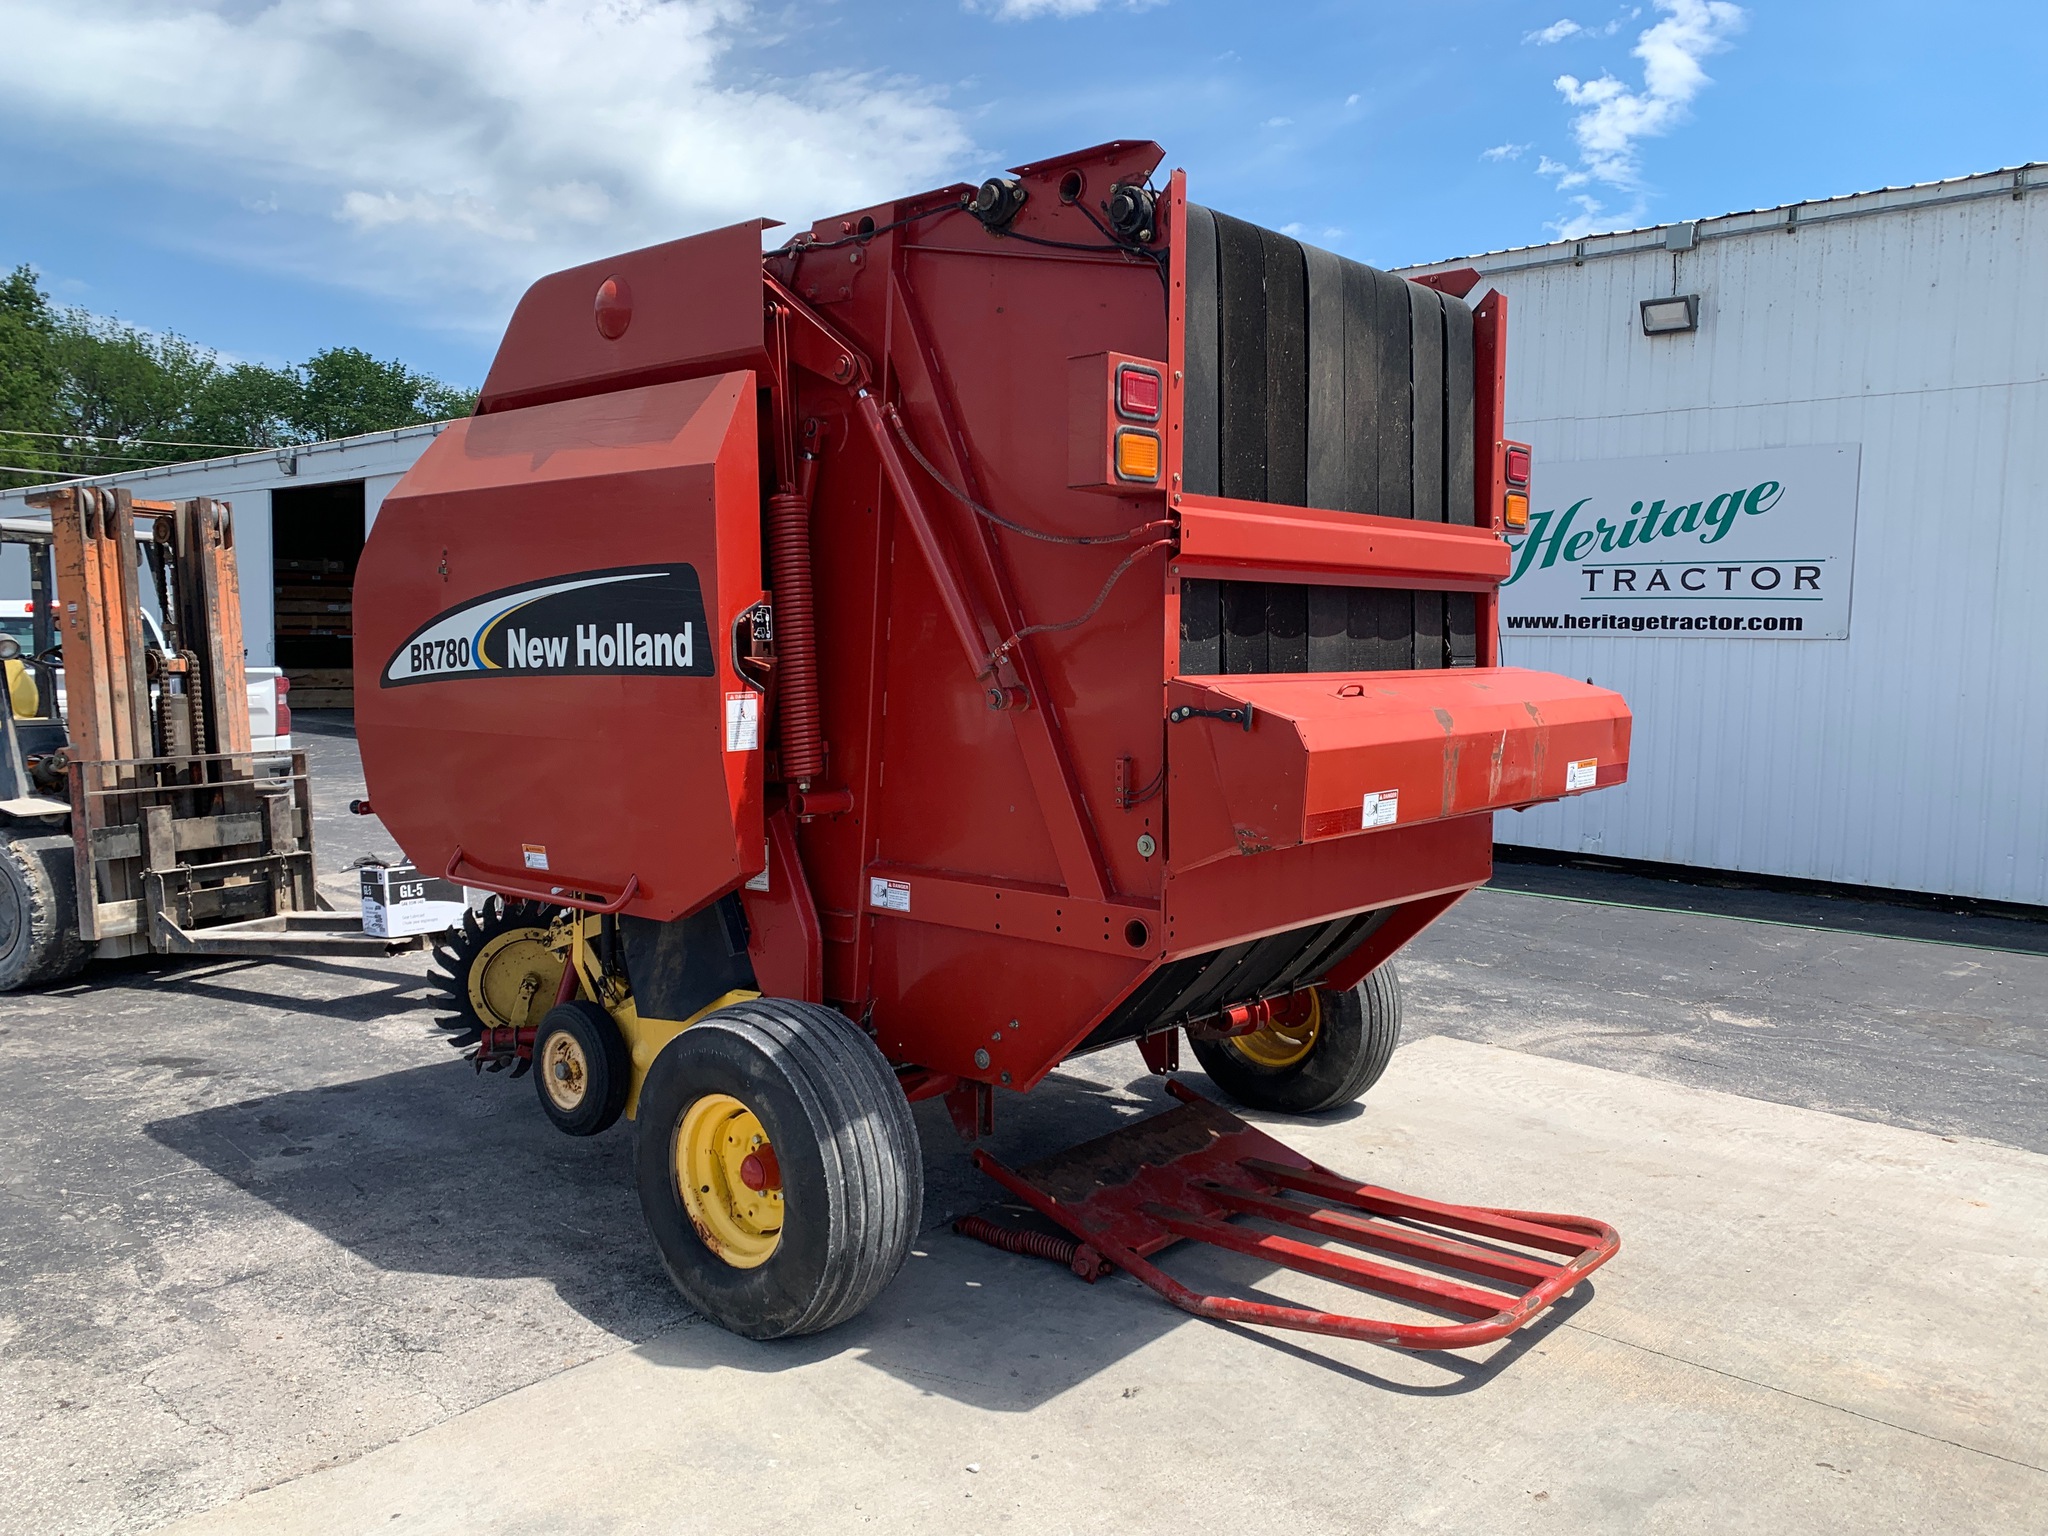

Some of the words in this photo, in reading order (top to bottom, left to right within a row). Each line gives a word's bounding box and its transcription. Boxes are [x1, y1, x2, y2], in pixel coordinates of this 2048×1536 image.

[1500, 481, 1785, 586] Heritage
[1582, 566, 1821, 592] TRACTOR
[1507, 614, 1802, 631] www.heritagetractor.com
[410, 637, 469, 673] BR780
[507, 628, 568, 669] New
[576, 622, 692, 667] Holland
[400, 883, 423, 898] GL-5
